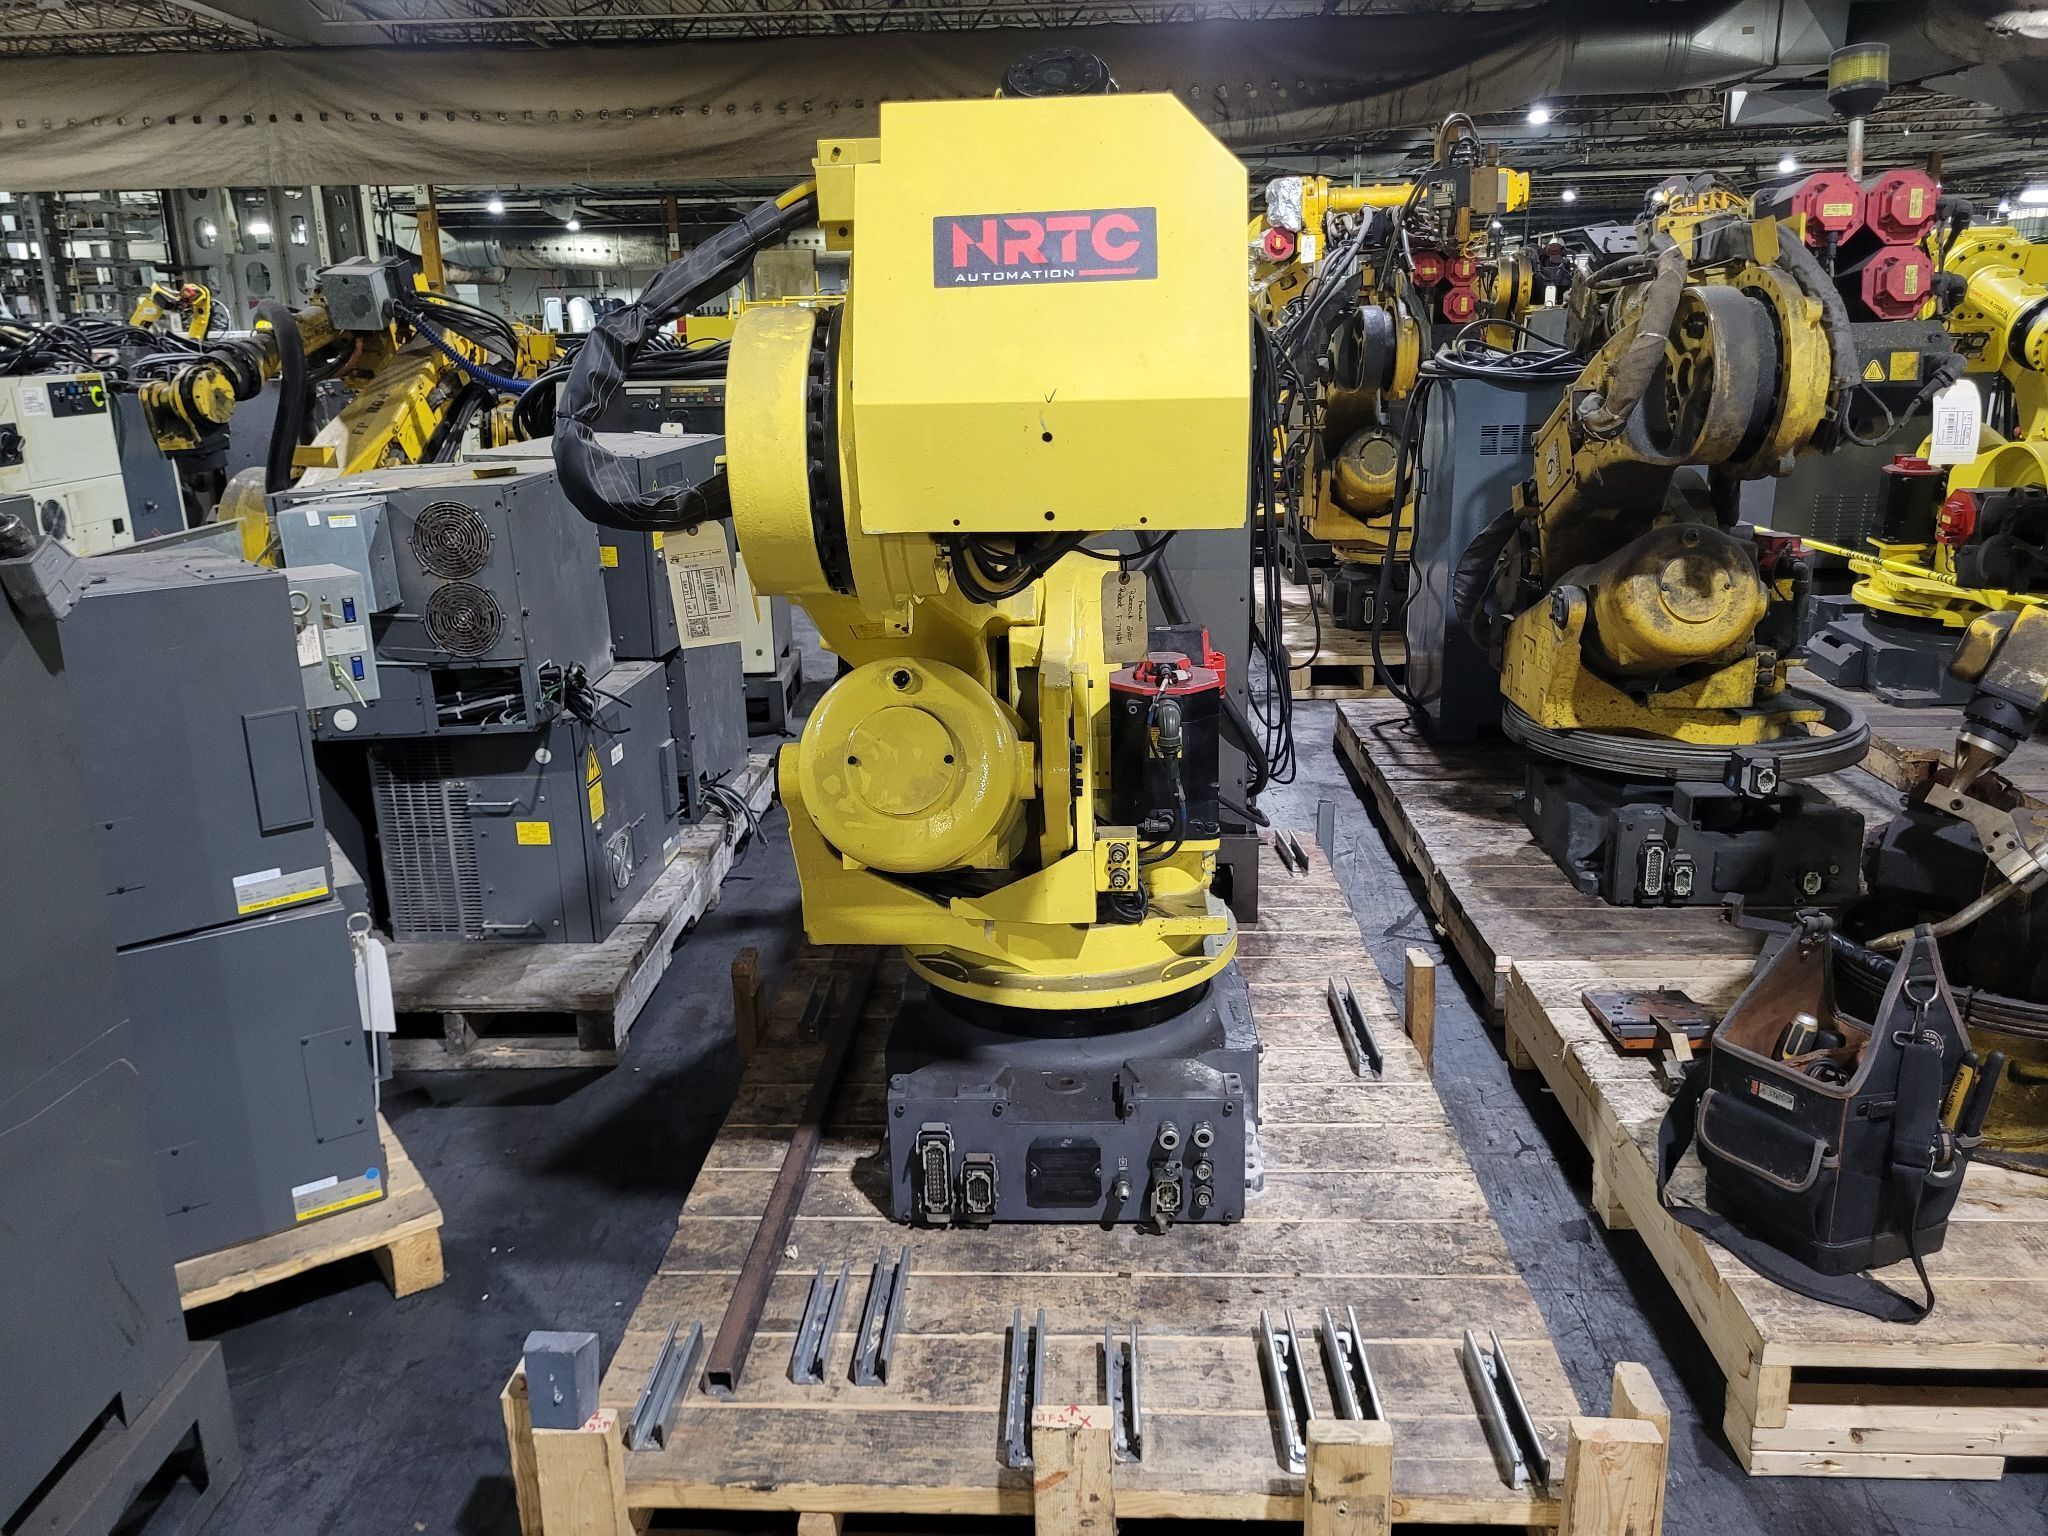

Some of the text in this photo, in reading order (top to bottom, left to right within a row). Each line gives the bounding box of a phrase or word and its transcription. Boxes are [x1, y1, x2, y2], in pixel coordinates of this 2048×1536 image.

[952, 213, 1140, 268] NRTC
[954, 269, 1075, 282] AUTOMATION
[1944, 1072, 1965, 1116] KLEIN TOOLS
